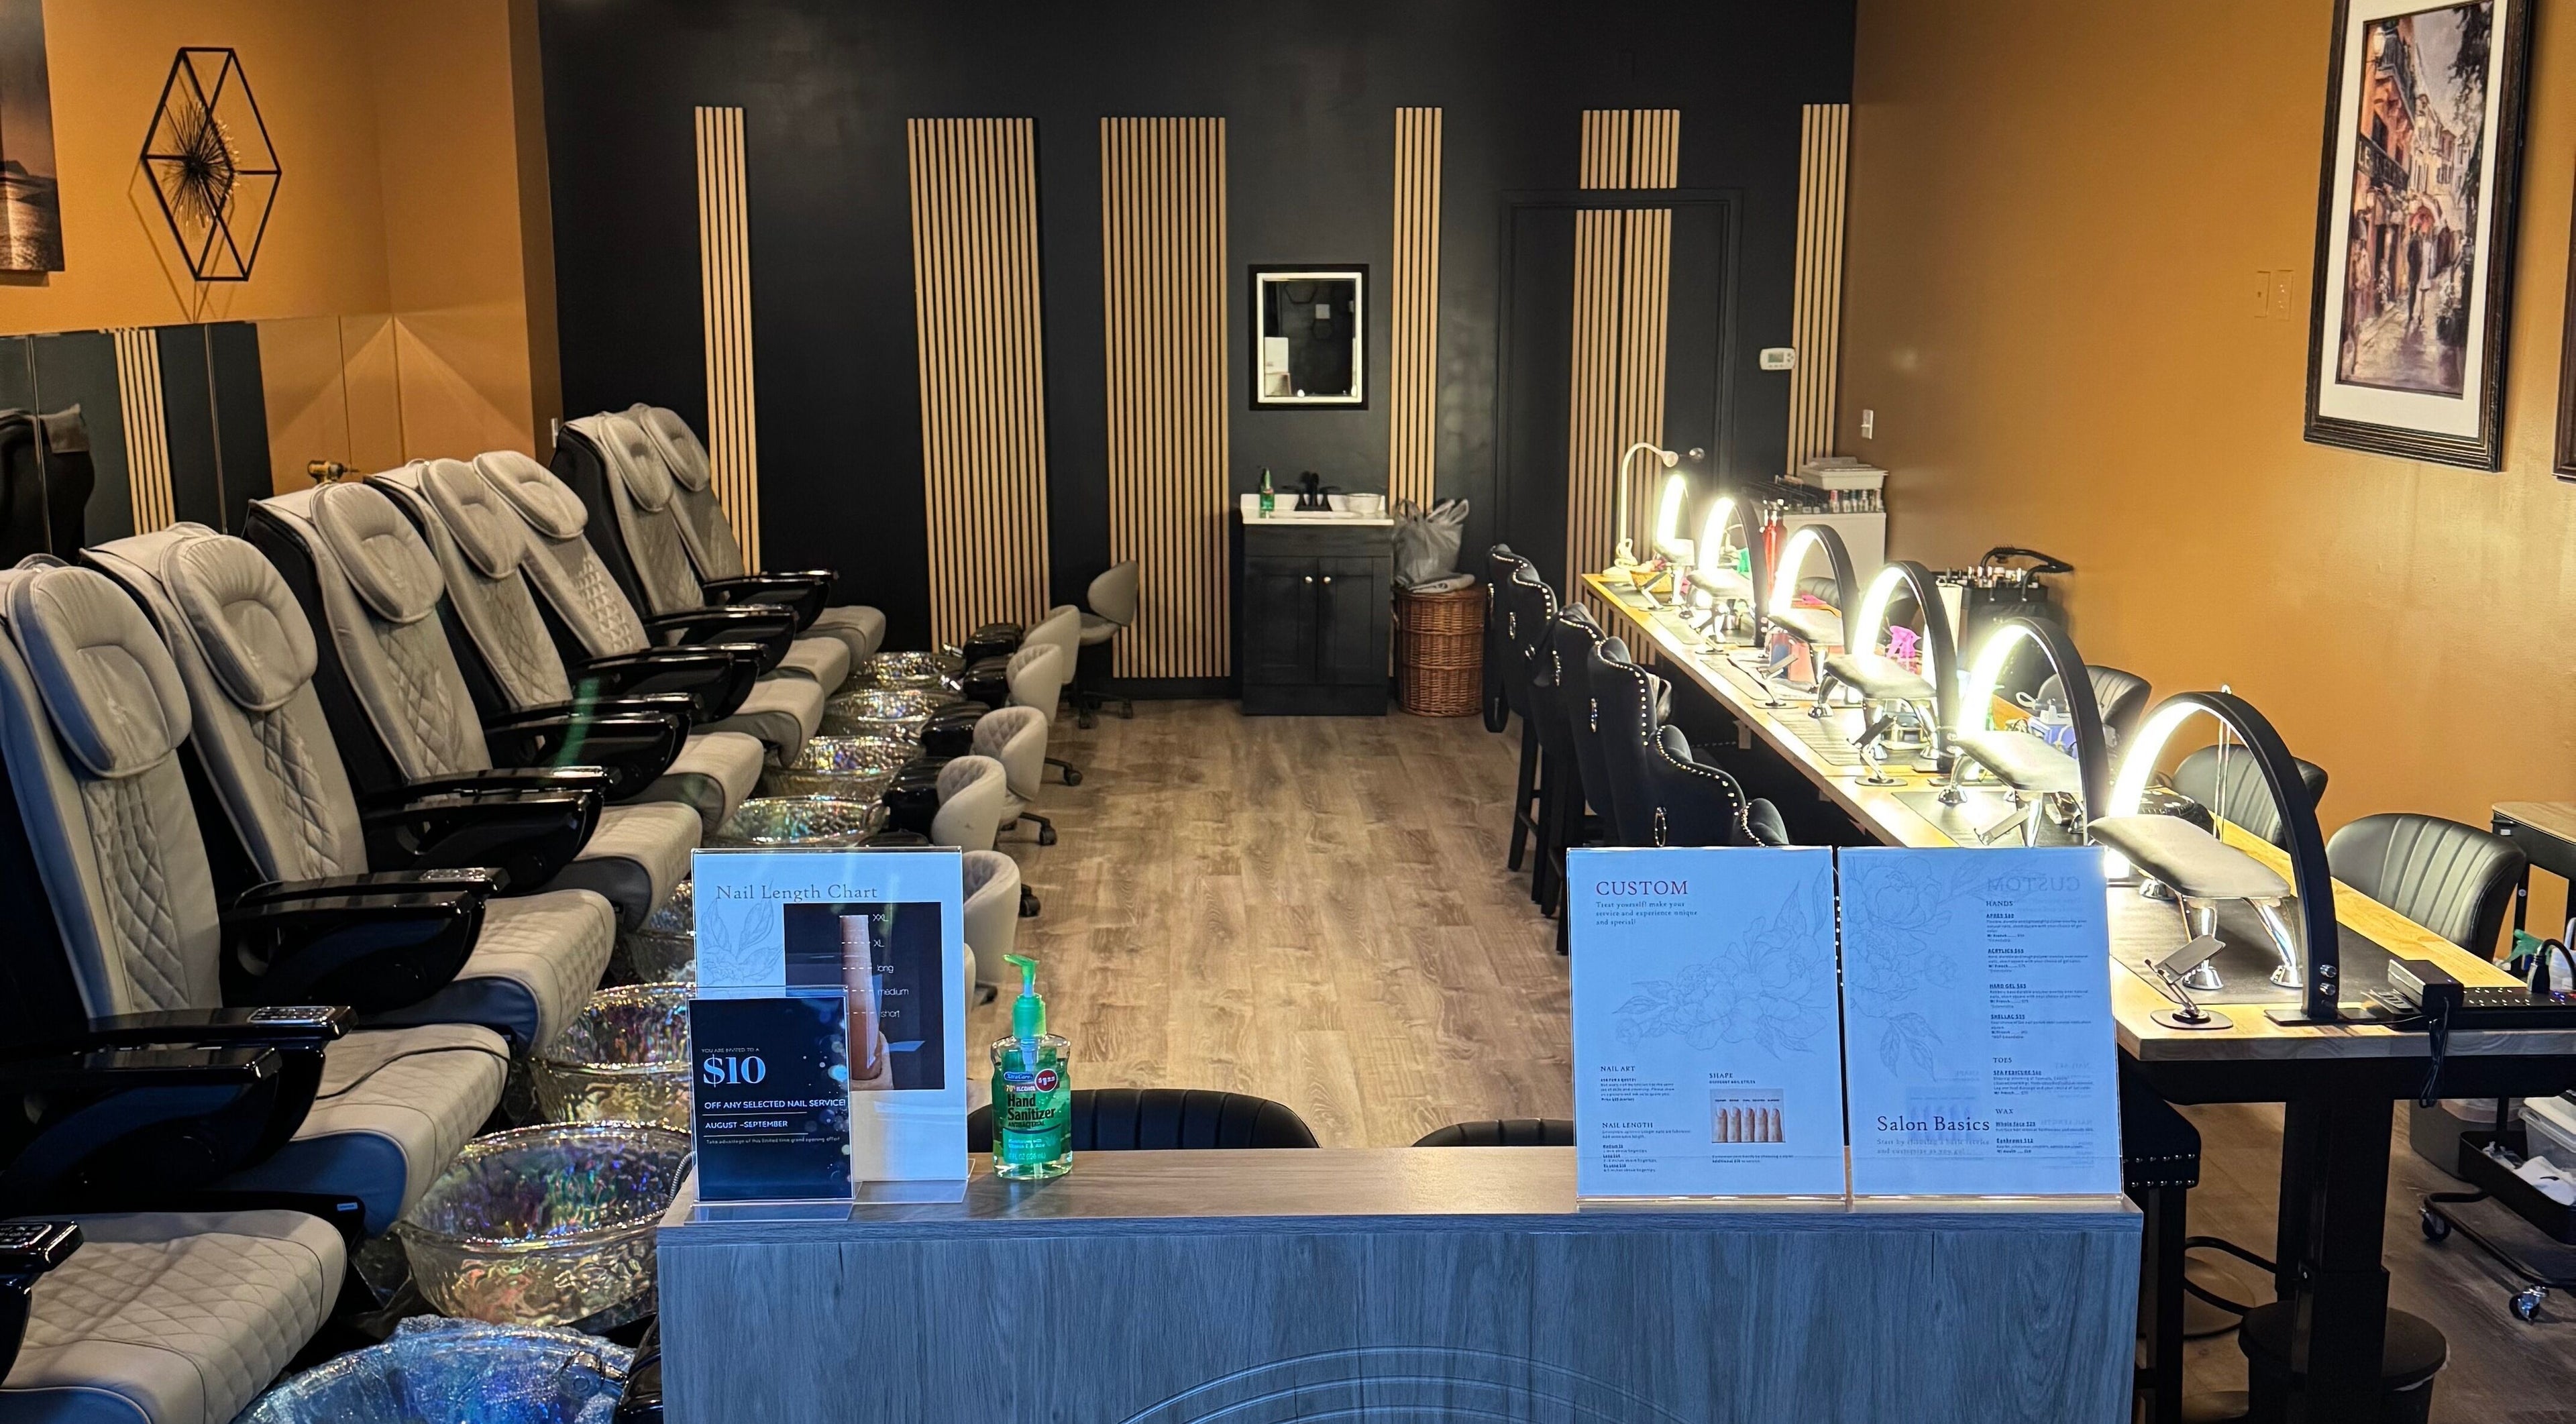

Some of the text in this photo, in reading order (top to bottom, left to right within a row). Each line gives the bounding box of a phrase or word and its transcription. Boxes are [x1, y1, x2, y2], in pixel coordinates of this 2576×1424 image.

[716, 884, 877, 903] Nail Length Chart
[1596, 880, 1688, 895] CUSTOM
[873, 914, 889, 922] XXL
[877, 965, 894, 973] long
[877, 987, 909, 995] medium
[880, 1010, 900, 1018] short
[703, 1054, 766, 1088] $10
[704, 1101, 722, 1109] OFF
[743, 1100, 786, 1109] SELECTED
[1008, 1093, 1036, 1107] Hand
[1008, 1107, 1056, 1121] Sanitizer
[1878, 1115, 1990, 1132] Salon Basics
